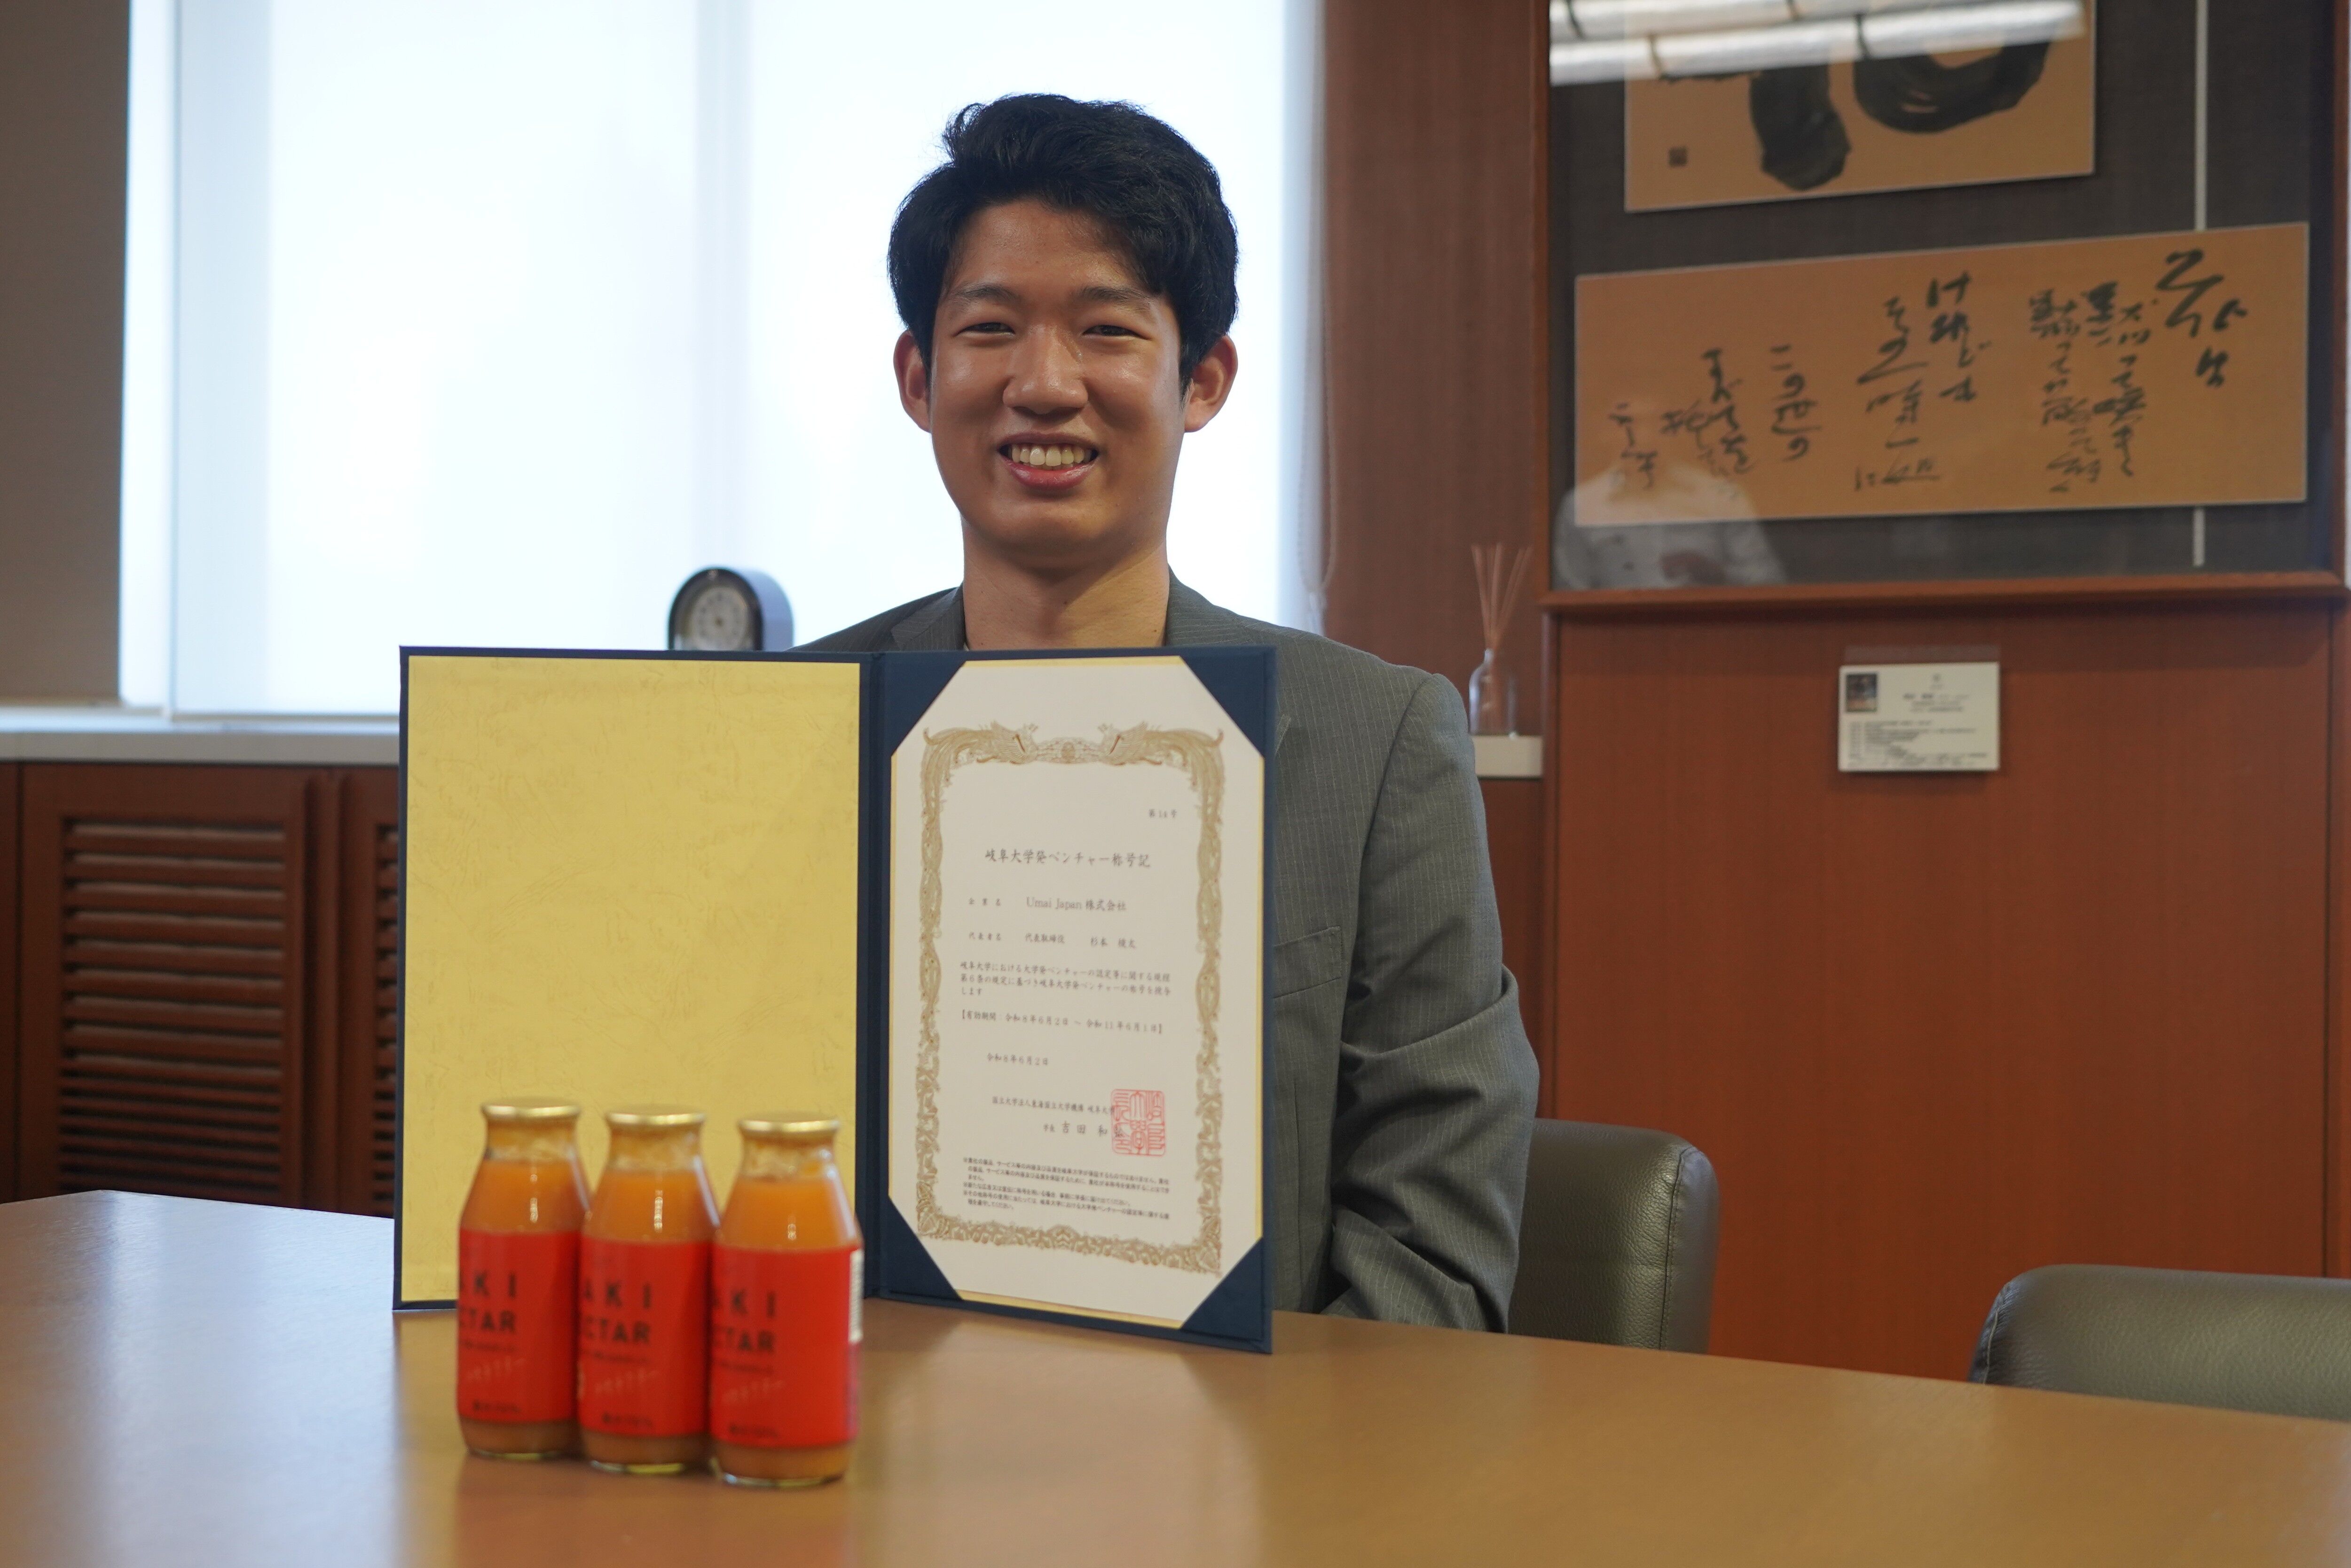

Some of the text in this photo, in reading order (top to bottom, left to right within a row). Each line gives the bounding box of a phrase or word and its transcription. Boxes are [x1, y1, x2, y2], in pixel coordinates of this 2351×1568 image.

[985, 848, 1151, 869] 岐阜大学発ベンチャー称号記
[1026, 896, 1127, 912] Umai Japan 株式会社
[961, 987, 983, 996] します
